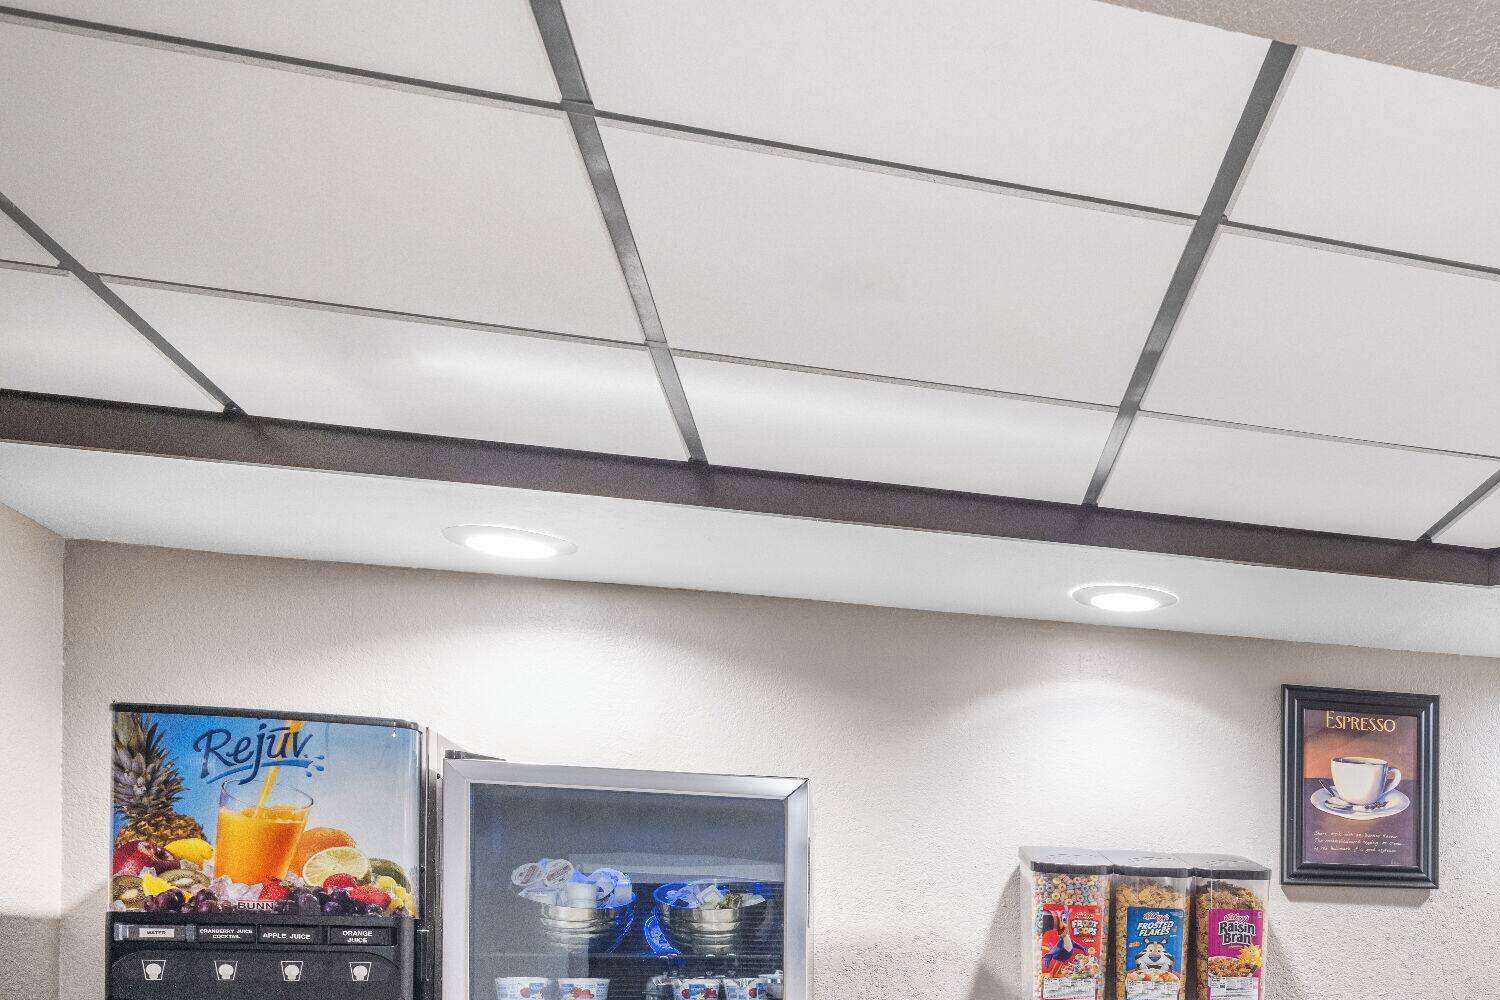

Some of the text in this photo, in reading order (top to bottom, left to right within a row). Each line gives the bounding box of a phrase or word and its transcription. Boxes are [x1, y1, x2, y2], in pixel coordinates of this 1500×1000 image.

[1326, 710, 1396, 733] ESPRESSO
[237, 901, 275, 911] BUNN
[1136, 920, 1175, 931] FROSTED
[1218, 920, 1256, 935] Raisin
[262, 931, 311, 941] APPLE JUICE
[342, 929, 373, 937] ORANGE
[1138, 928, 1171, 937] FLAKES
[346, 936, 368, 944] JUICE
[1223, 932, 1252, 945] Bran
